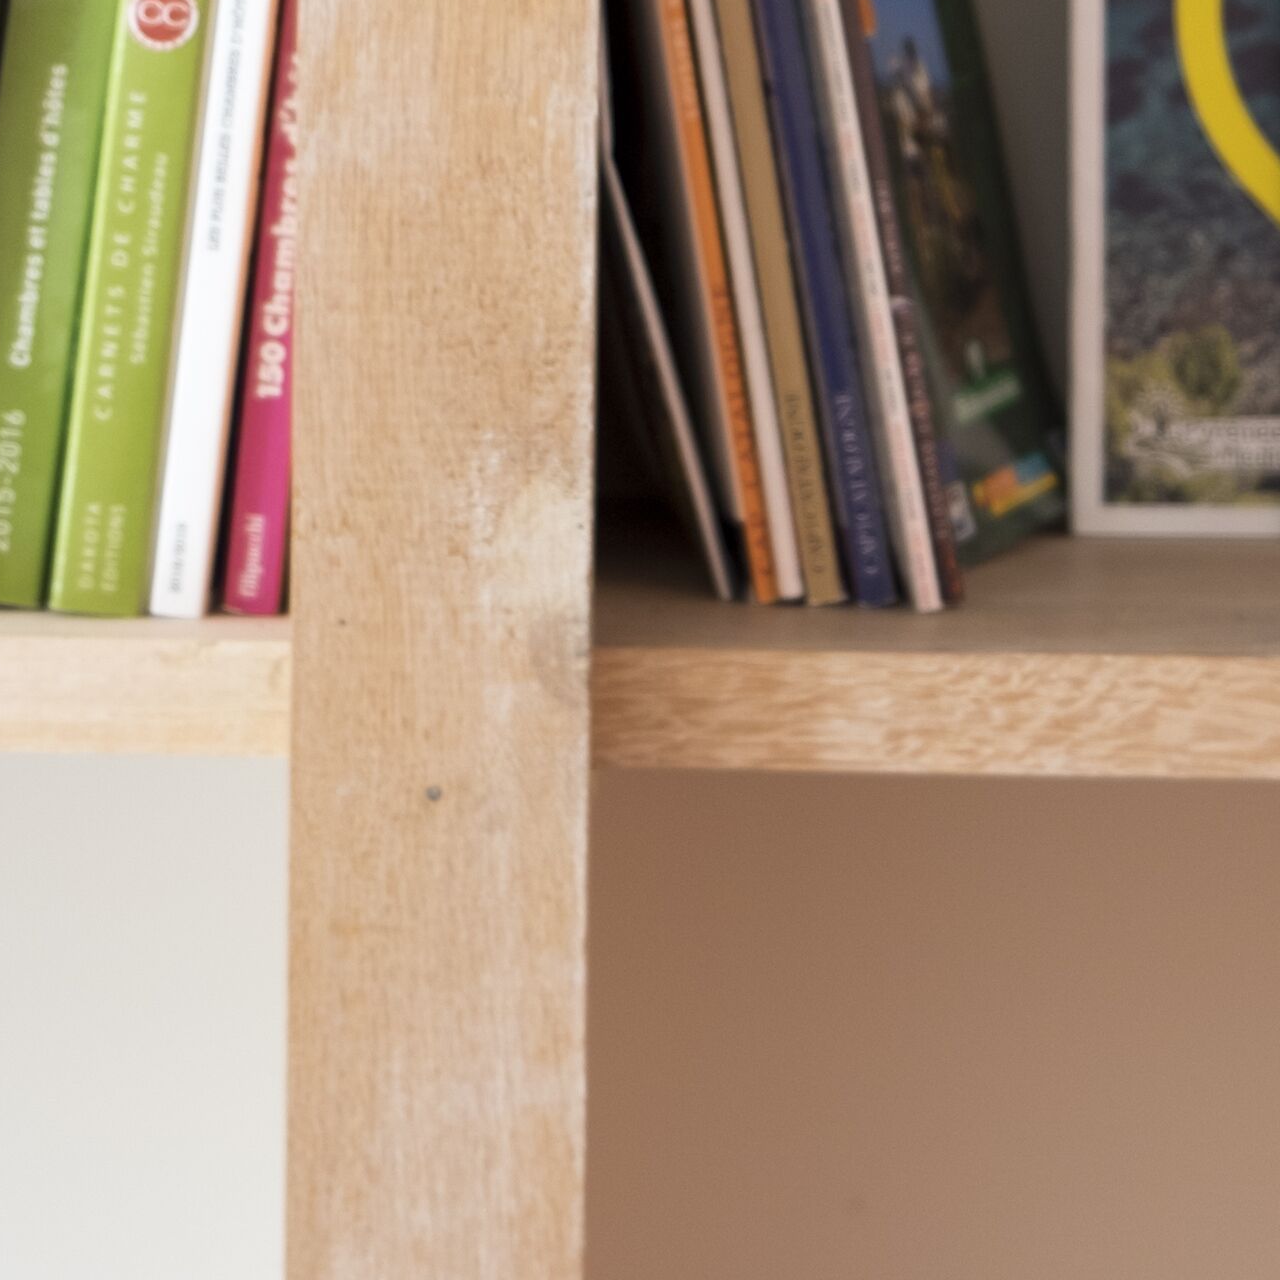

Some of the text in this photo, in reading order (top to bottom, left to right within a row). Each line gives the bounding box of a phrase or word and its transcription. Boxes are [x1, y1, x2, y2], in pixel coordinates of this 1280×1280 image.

[30, 152, 57, 220] tables
[29, 226, 46, 248] et
[94, 91, 147, 420] CARNETS DE CHARME
[9, 255, 43, 367] Chambres
[256, 341, 287, 399] 150
